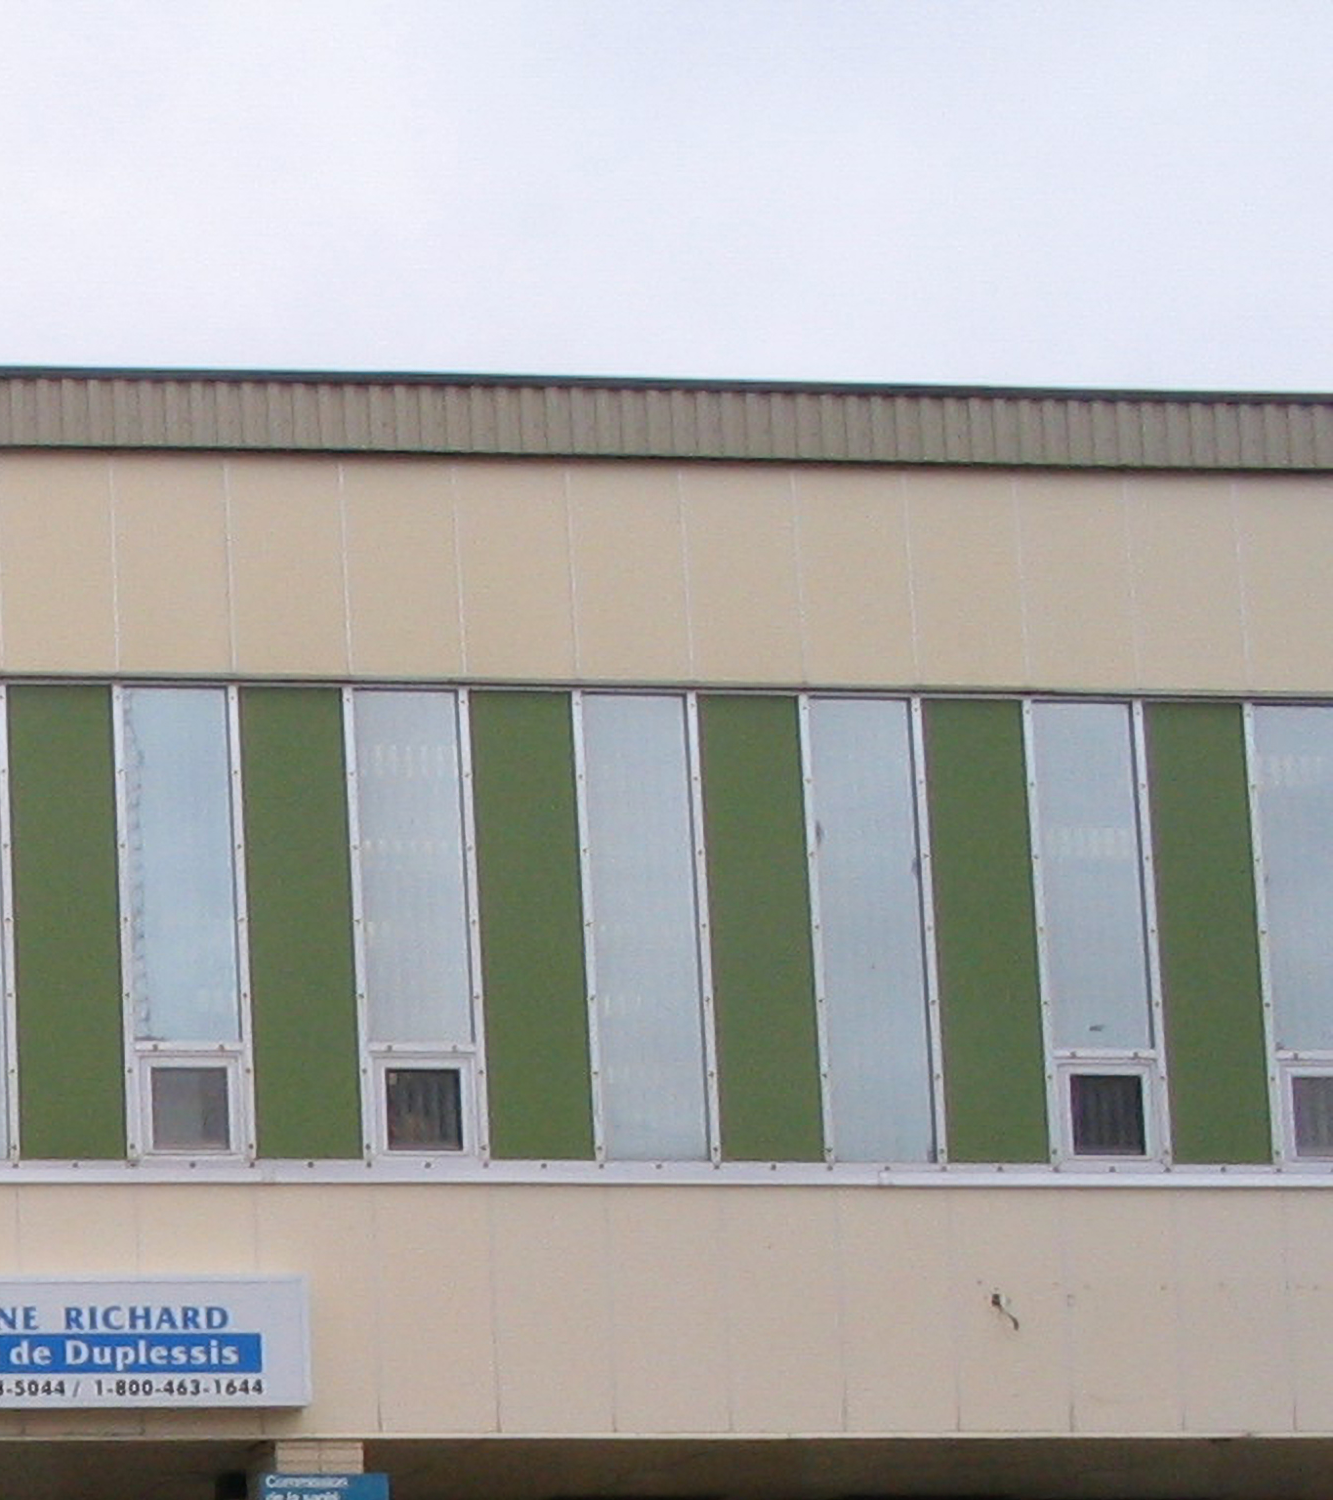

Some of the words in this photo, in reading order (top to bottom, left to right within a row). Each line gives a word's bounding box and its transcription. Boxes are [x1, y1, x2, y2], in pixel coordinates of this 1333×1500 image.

[65, 1305, 229, 1331] RICHARD
[10, 1340, 53, 1367] de
[65, 1340, 239, 1372] Duplessis
[94, 1378, 264, 1397] 1-800-463-1644
